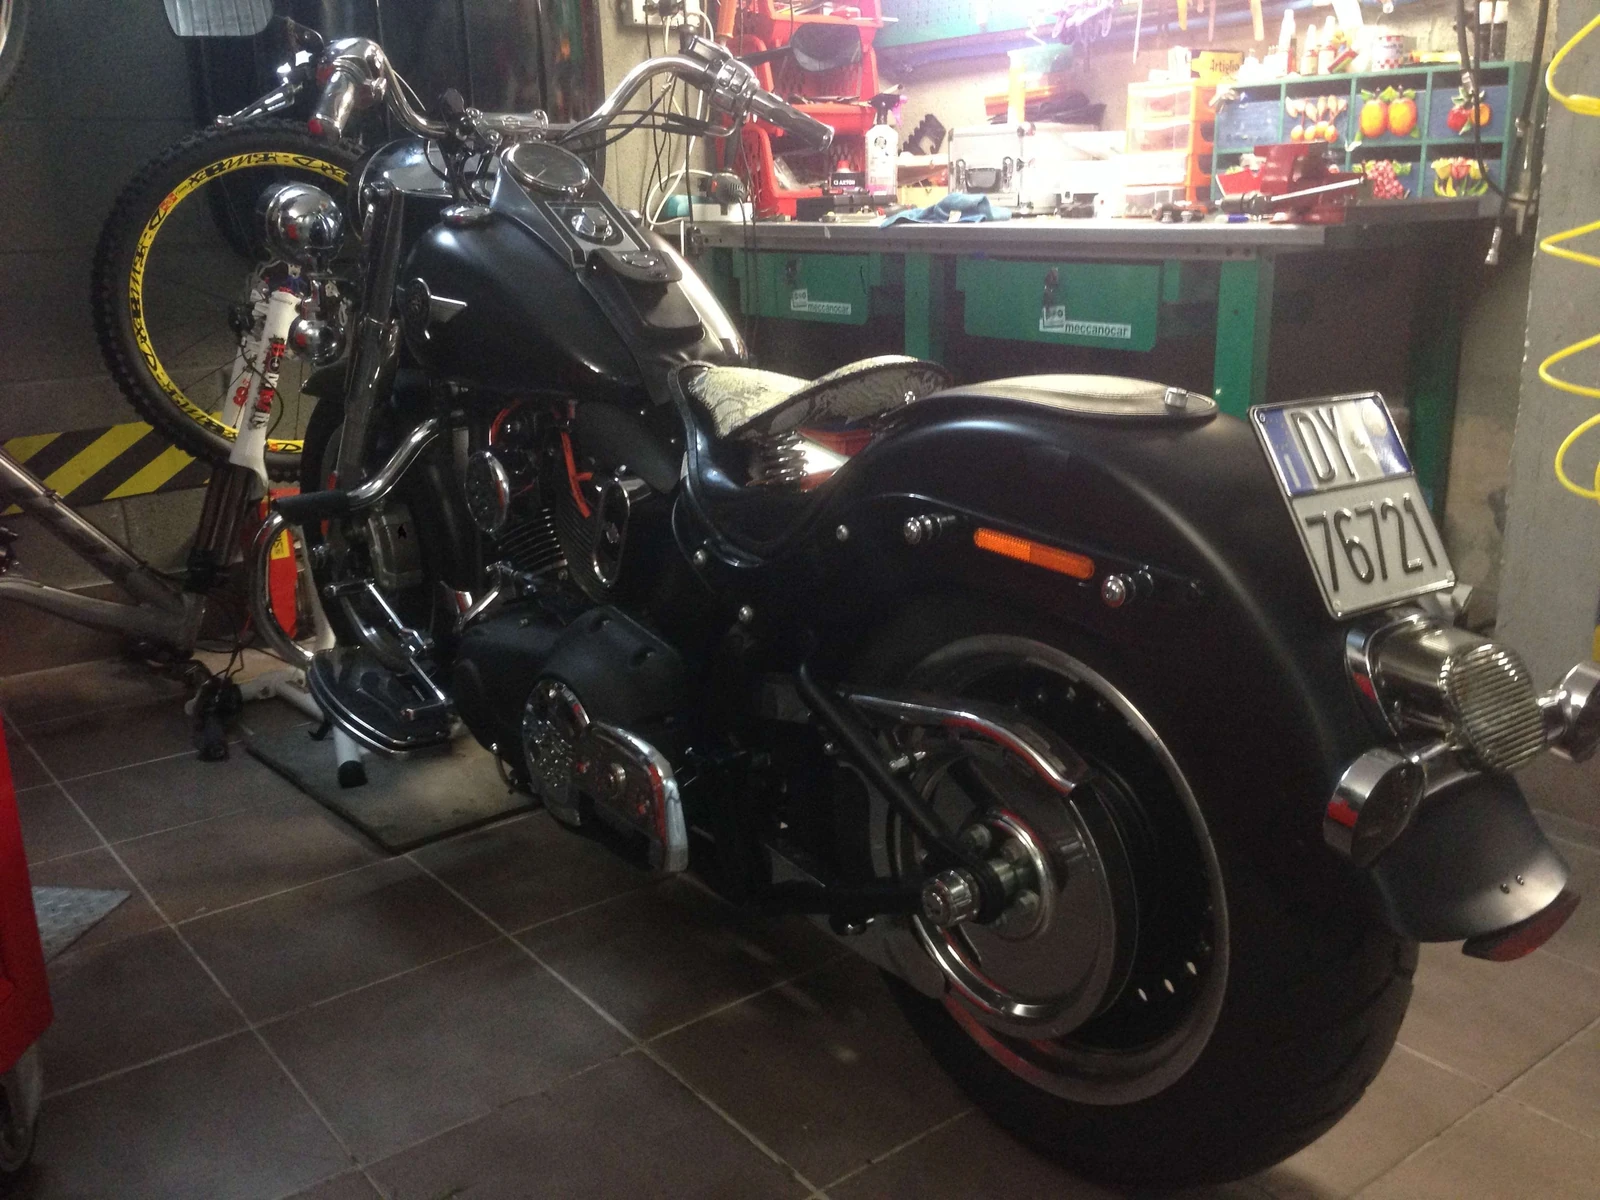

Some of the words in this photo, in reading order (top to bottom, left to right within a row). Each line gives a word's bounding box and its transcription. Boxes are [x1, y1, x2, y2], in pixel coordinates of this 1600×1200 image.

[1065, 323, 1129, 337] meccanocar
[1291, 405, 1360, 484] DY
[1305, 493, 1438, 592] 76721
